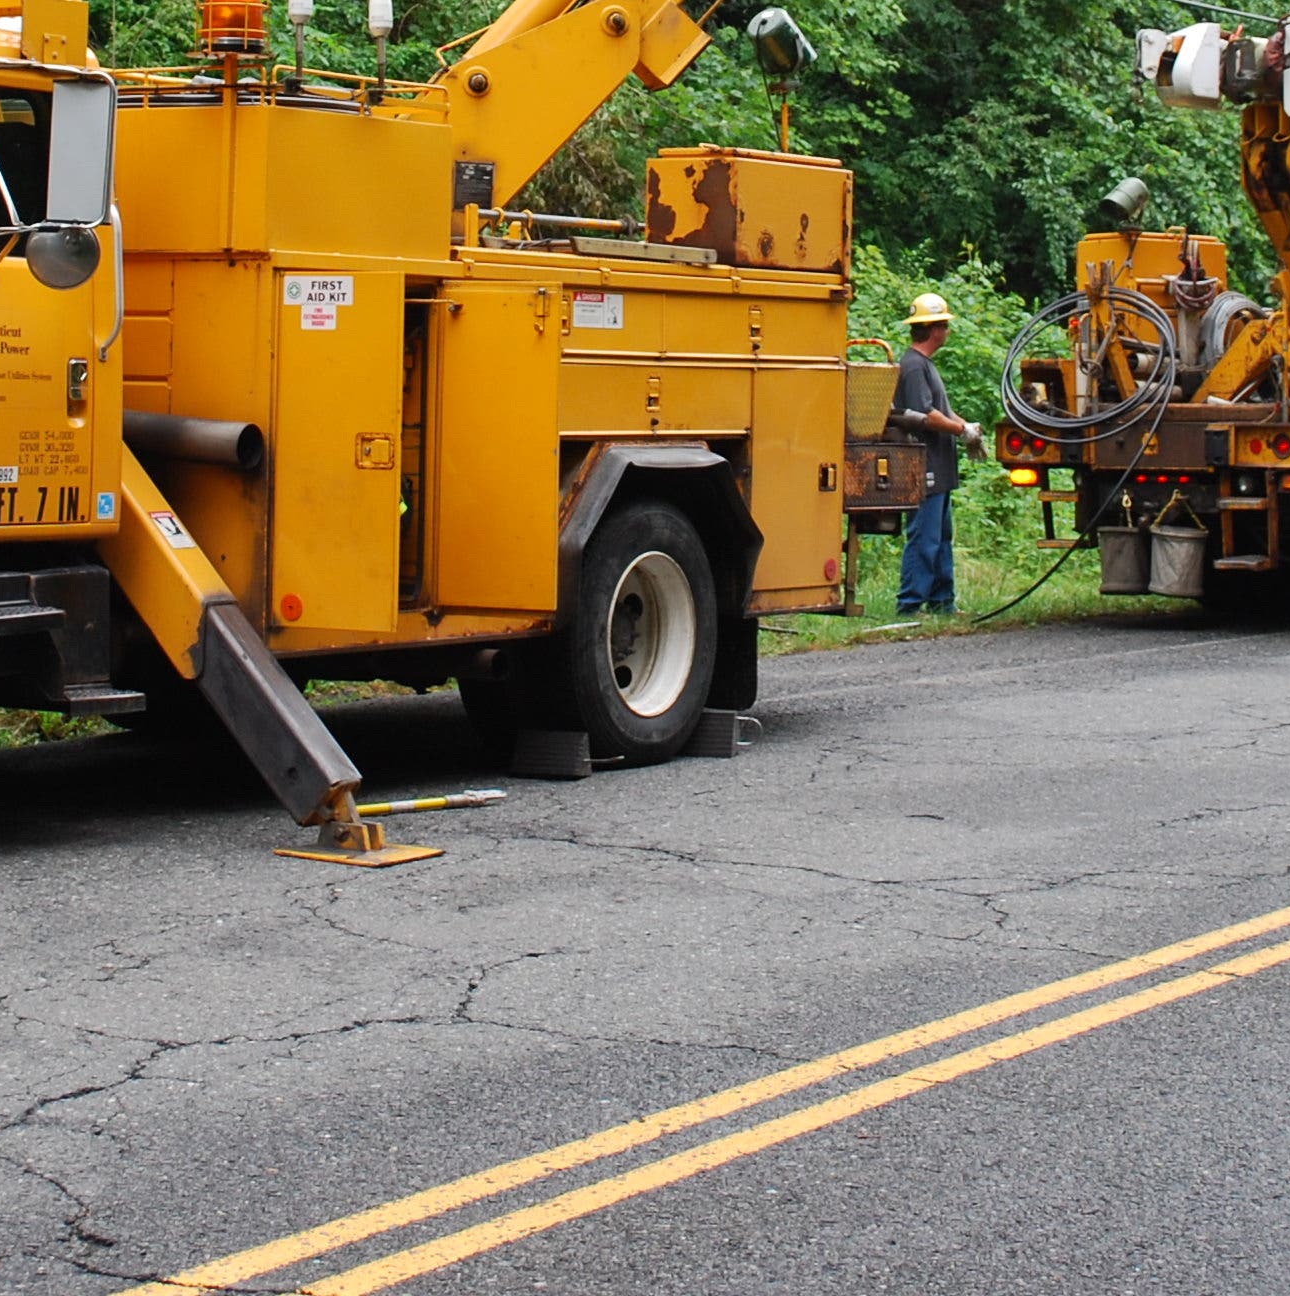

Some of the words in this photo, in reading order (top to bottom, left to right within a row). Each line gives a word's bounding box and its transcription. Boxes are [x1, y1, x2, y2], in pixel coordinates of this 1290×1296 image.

[311, 280, 343, 291] FIRST
[306, 292, 326, 302] AID
[329, 292, 347, 302] KIT
[0, 341, 30, 356] Power
[36, 486, 49, 523] 7
[58, 486, 86, 522] IN.
